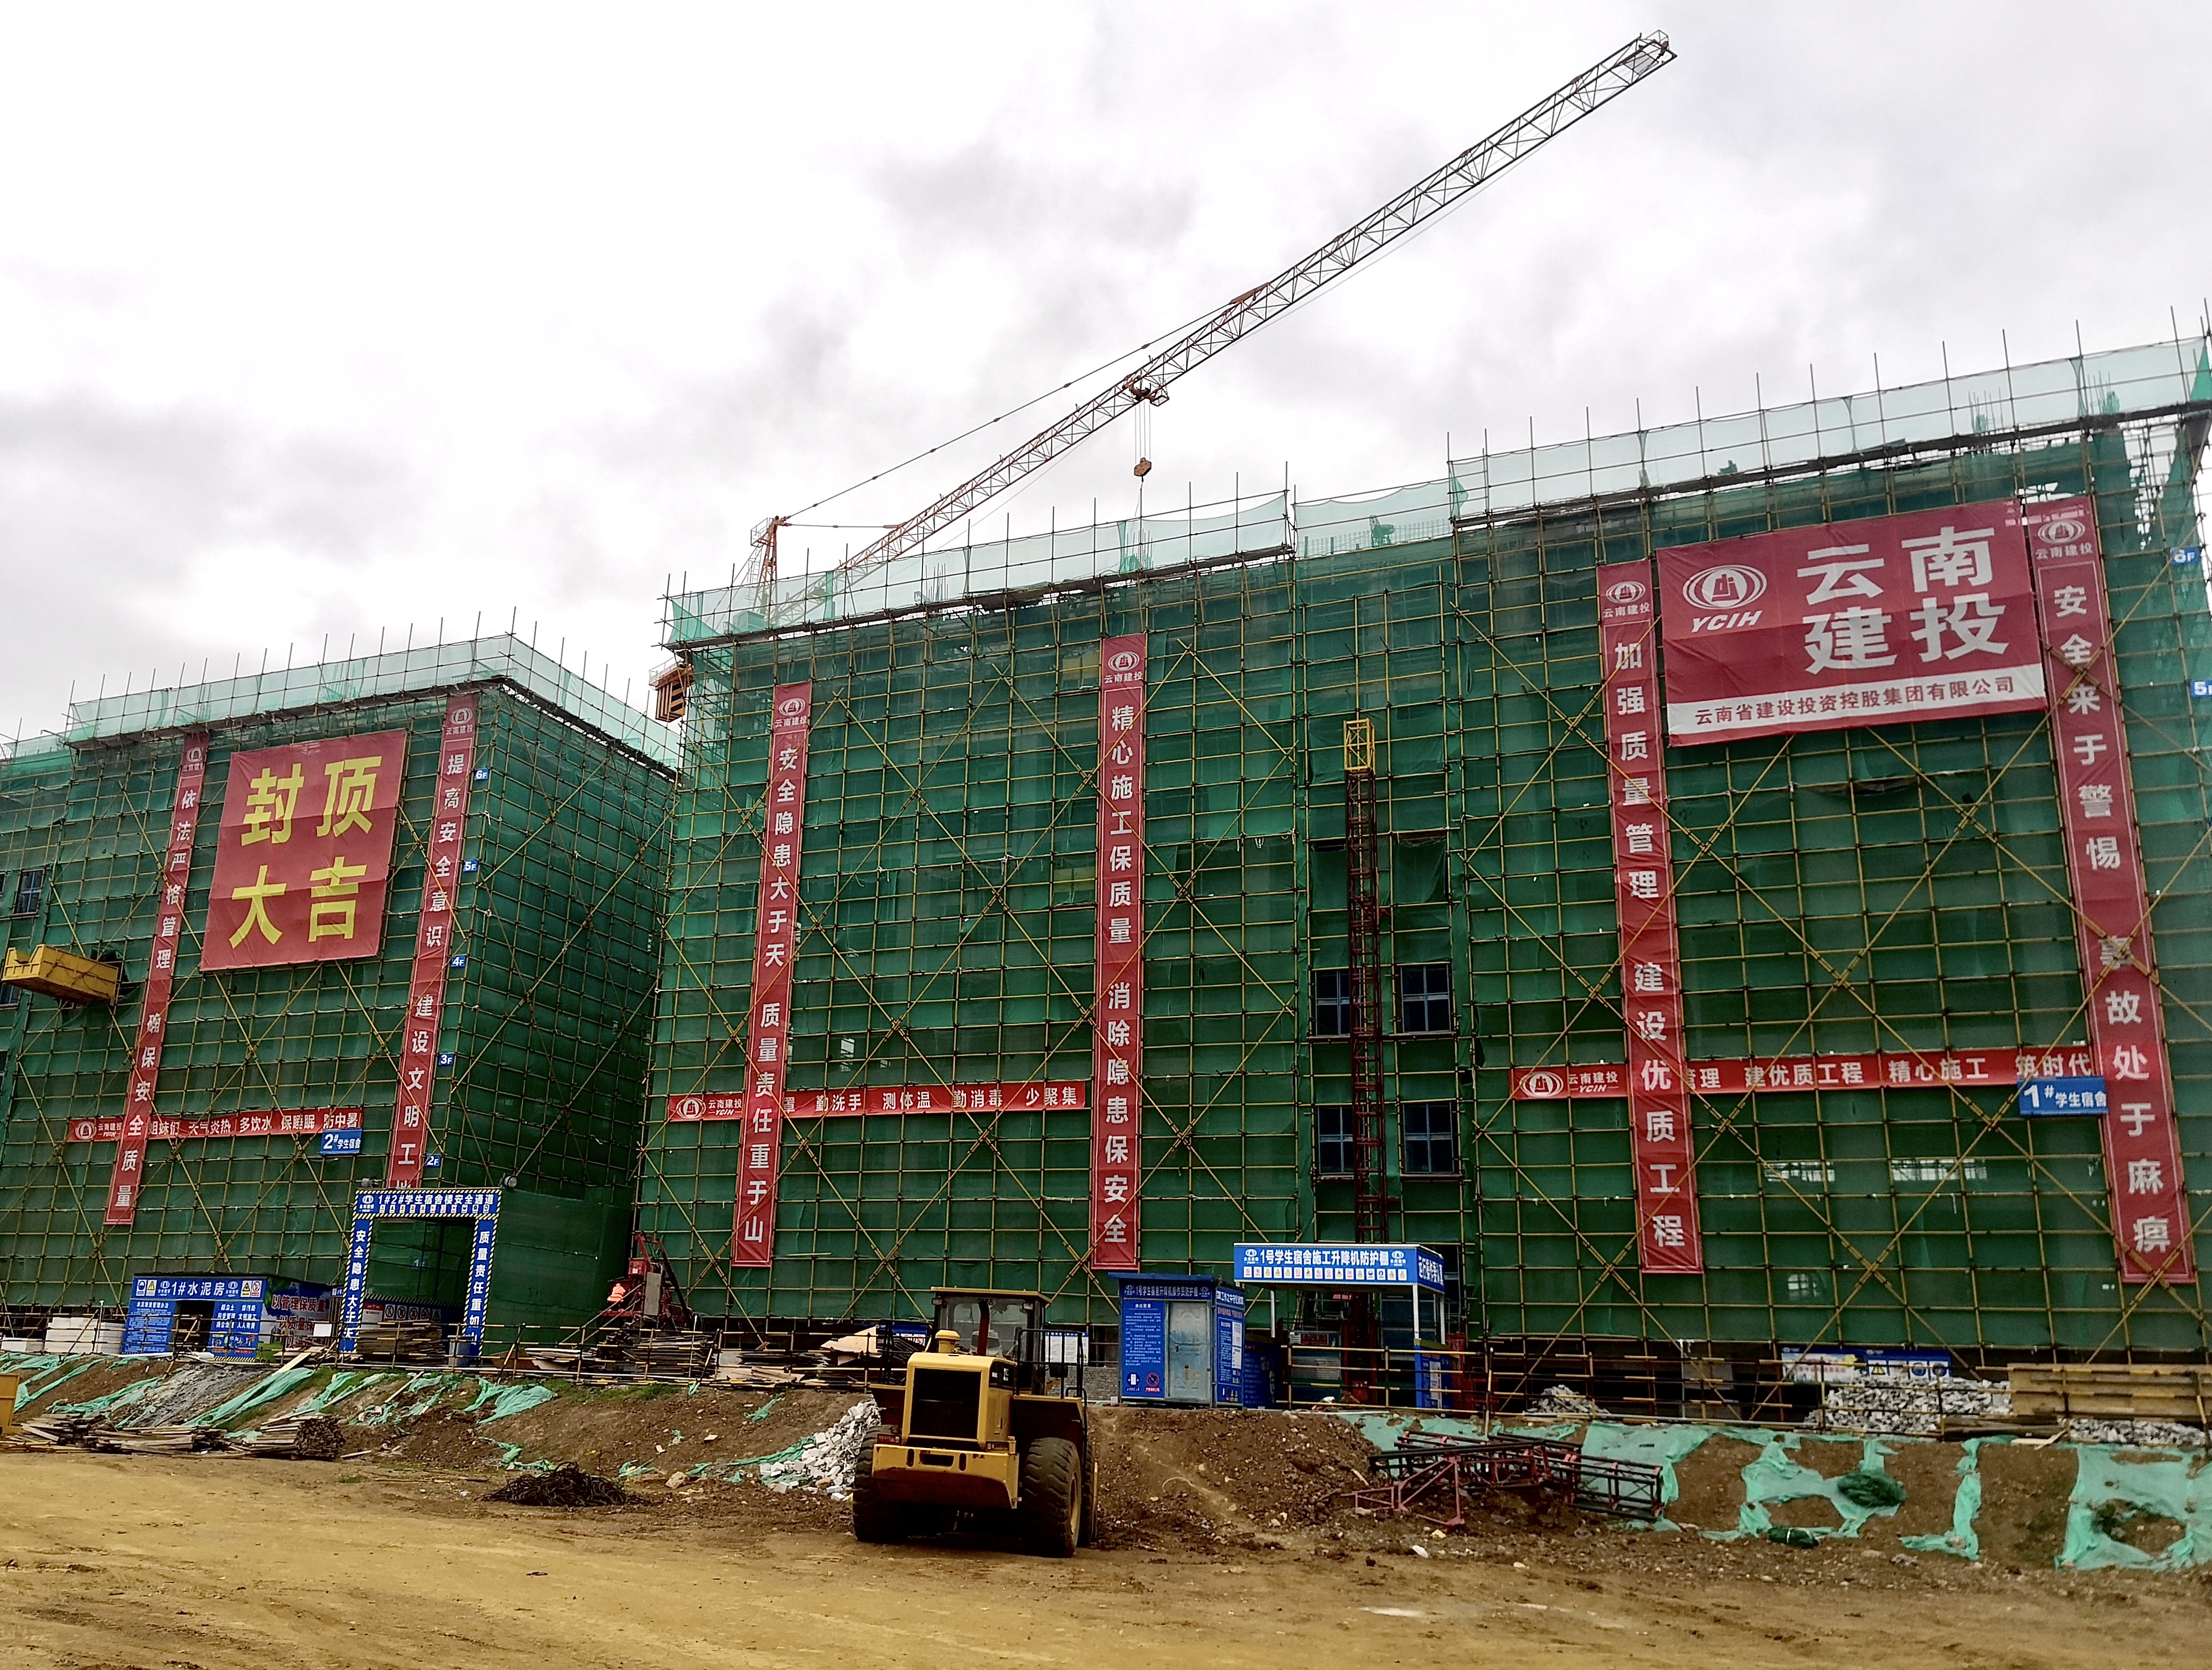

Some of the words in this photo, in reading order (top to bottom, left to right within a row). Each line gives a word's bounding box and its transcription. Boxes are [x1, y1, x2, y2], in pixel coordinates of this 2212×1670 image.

[2036, 542, 2093, 560] 云南建投
[2174, 549, 2195, 563] 6F
[1797, 526, 1994, 605] 云南
[1603, 603, 1651, 618] 云南建投
[1690, 610, 1763, 632] YCIH
[1802, 593, 2009, 675] 建投
[1104, 671, 1143, 684] 云南建投
[1695, 676, 2014, 725] 云南省建设投资控股集团有限公司
[446, 725, 473, 735] 云南建投
[775, 714, 807, 727] 云南建投
[2054, 585, 2121, 870] 安全来于警惕
[476, 769, 487, 780] 6F
[1615, 642, 1659, 899] 加强质量管理
[241, 756, 381, 846] 封顶
[1108, 706, 1134, 944] 精心施工保质量
[425, 754, 465, 948] 提高安全意识
[766, 747, 797, 968] 安全隐患大于天
[465, 861, 476, 871] 5F
[155, 789, 196, 970] 依法严格管理
[229, 856, 368, 949] 大吉
[452, 957, 465, 966] 4F
[440, 1054, 452, 1064] 3F
[1568, 1071, 1618, 1084] 云南建投
[1745, 1061, 1864, 1087] 建优质工程
[1889, 1057, 1988, 1083] 精心施工
[815, 1093, 862, 1112] 勤洗手
[883, 1091, 931, 1110] 测体温
[953, 1089, 1003, 1108] 勤消毒
[1026, 1086, 1077, 1107] 少聚集
[1579, 1084, 1607, 1093] YCIH
[116, 1011, 161, 1208] 确保安全质量
[708, 1099, 742, 1109] 云南建投
[1103, 981, 1131, 1244] 消除隐患保安全
[1634, 962, 1685, 1248] 建设优质工程
[189, 1119, 231, 1135] 天气炎热
[240, 1115, 271, 1133] 多饮水
[281, 1114, 315, 1130] 保睡眠
[745, 1003, 780, 1243] 质量责任重于山
[427, 1155, 439, 1166] 2F
[378, 1194, 494, 1205] 1#2#学生宿舍楼安全通道
[1260, 1249, 1389, 1266] 1号学生宿舍施工升降机防护棚
[172, 1281, 225, 1296] 1#水泥房
[272, 1294, 326, 1312] 以管理保质量
